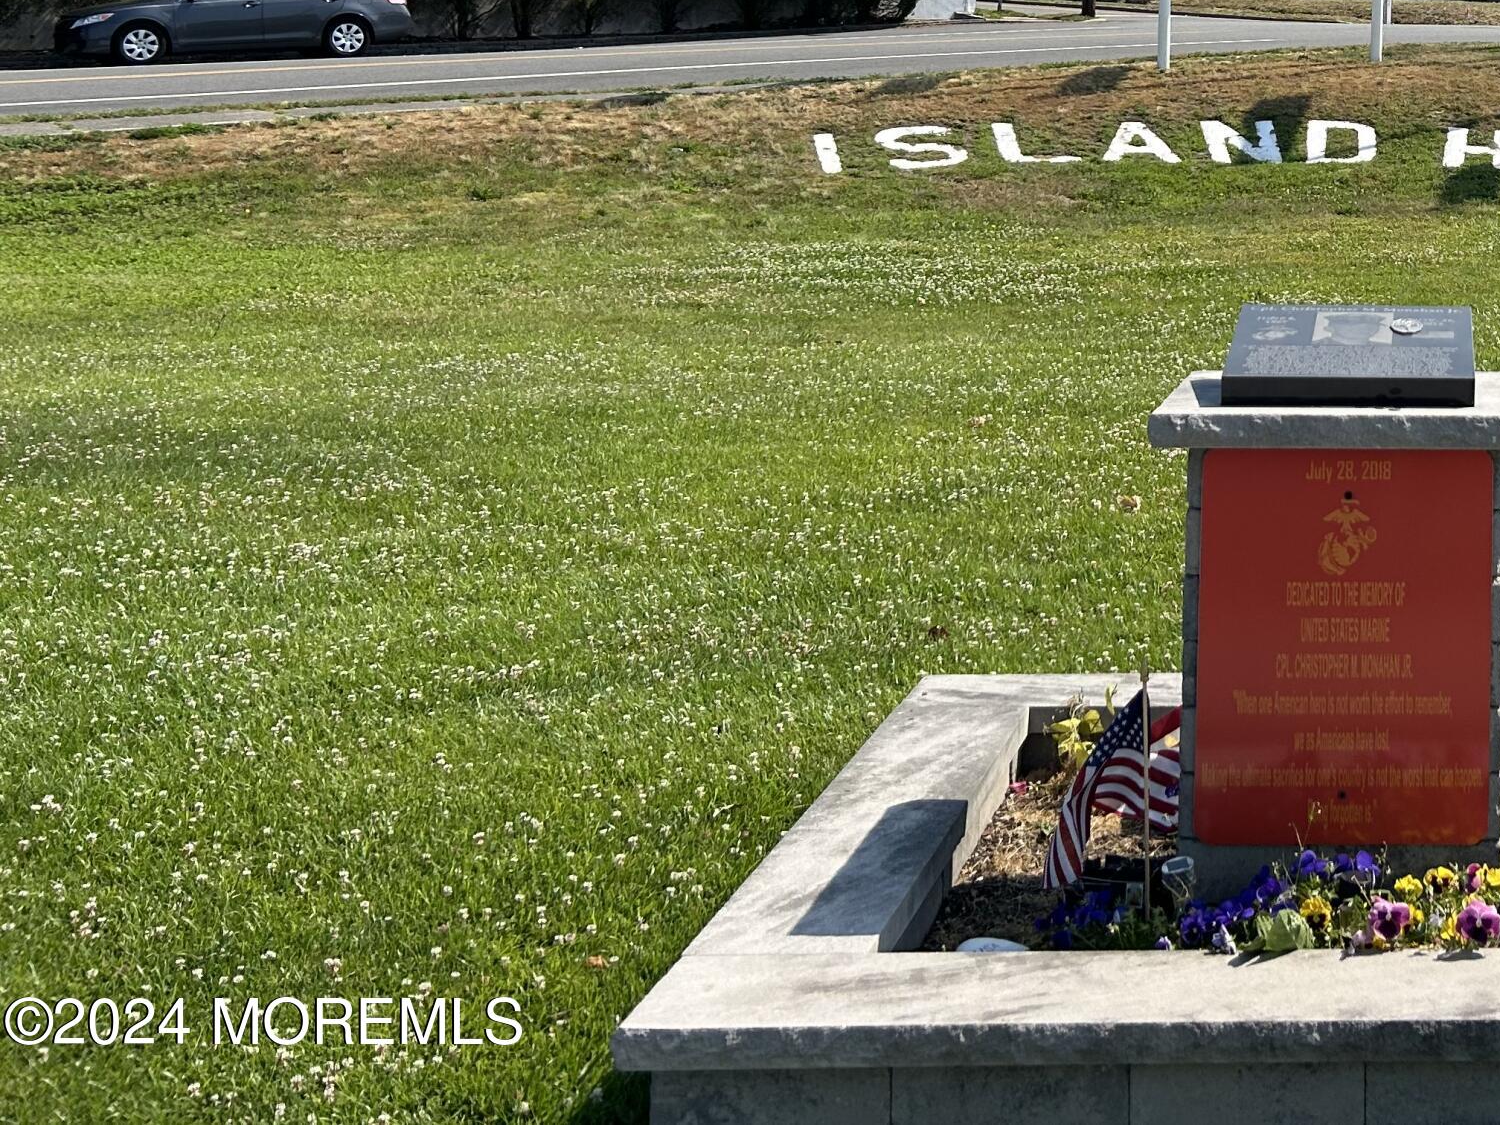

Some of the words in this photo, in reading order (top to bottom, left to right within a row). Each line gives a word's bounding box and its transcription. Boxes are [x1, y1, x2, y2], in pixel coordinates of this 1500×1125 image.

[812, 119, 1377, 174] ISLAND
[1305, 461, 1333, 484] July
[1336, 461, 1358, 481] 28,
[1362, 461, 1392, 481] 2018
[1286, 581, 1329, 606] DEDICATED
[1331, 581, 1342, 606] TO
[1343, 581, 1358, 606] THE
[1359, 581, 1393, 606] MEMORY
[1394, 581, 1406, 606] OF
[1300, 617, 1329, 643] UNITED
[1330, 617, 1359, 643] STATES
[1360, 617, 1391, 643] MARINE
[1275, 654, 1293, 679] CPL.
[1294, 654, 1349, 679] CHRISTOPHER
[1350, 654, 1360, 679] M.
[1361, 654, 1400, 679] MONAHAN
[1401, 654, 1414, 679] JR.
[1258, 695, 1273, 715] one
[1274, 690, 1308, 715] American
[1310, 690, 1326, 715] hero
[1328, 690, 1335, 715] is
[1336, 690, 1348, 715] not
[1349, 690, 1370, 715] worth
[1372, 690, 1383, 715] the
[1385, 690, 1404, 715] effort
[1406, 690, 1413, 715] to
[1415, 690, 1453, 719] remember,
[1294, 732, 1304, 751] we
[1306, 732, 1315, 751] as
[1316, 726, 1354, 751] Americans
[1356, 726, 1374, 751] have
[1375, 726, 1391, 751] lost.
[1229, 763, 1240, 787] the
[1273, 763, 1303, 787] sacrifice
[1305, 763, 1316, 787] for
[1316, 763, 1336, 787] one's
[1338, 763, 1366, 793] country
[1368, 763, 1375, 787] is
[1376, 763, 1387, 787] not
[1390, 763, 1401, 787] the
[1402, 763, 1423, 787] worst
[1424, 763, 1439, 787] that
[1440, 768, 1453, 787] can
[1455, 763, 1483, 794] happen.
[1330, 798, 1363, 830] forgotten
